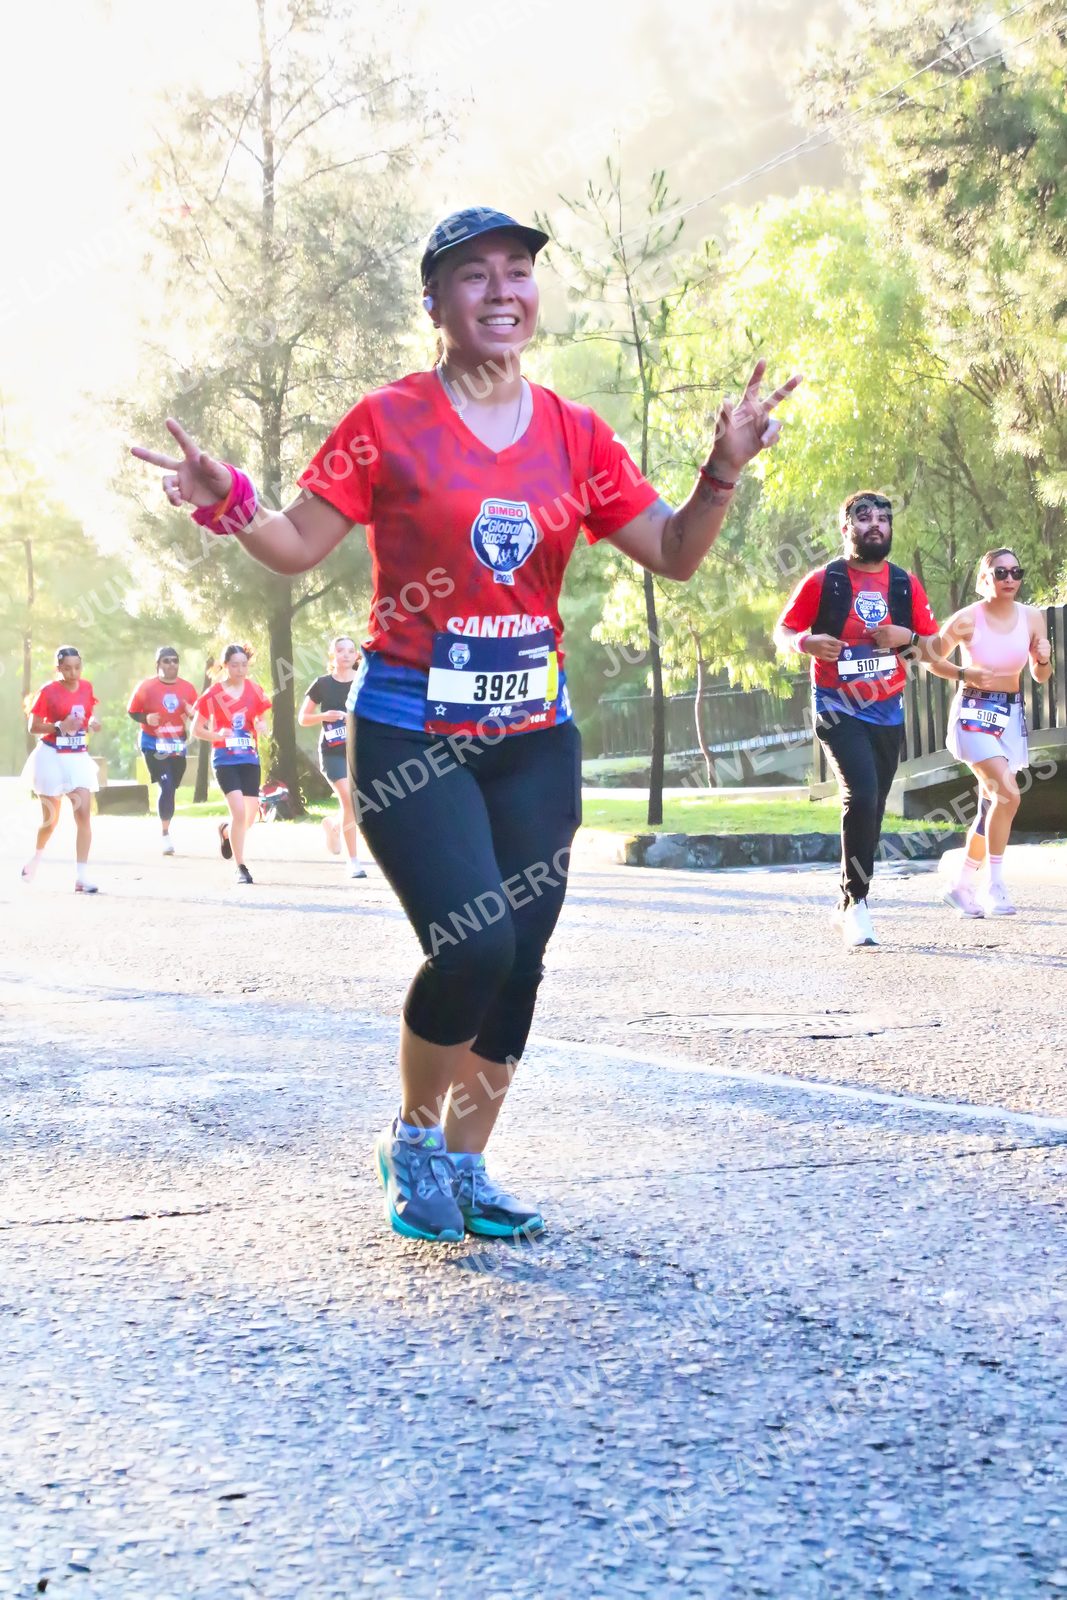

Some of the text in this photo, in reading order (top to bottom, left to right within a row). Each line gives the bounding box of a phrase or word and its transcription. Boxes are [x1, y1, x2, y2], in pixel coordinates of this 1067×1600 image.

[488, 506, 524, 518] BIMBO
[488, 520, 523, 535] Global
[481, 531, 508, 544] Race
[857, 659, 880, 672] 5107
[473, 672, 529, 702] 3924
[530, 713, 547, 724] 10K
[977, 710, 998, 724] 5106
